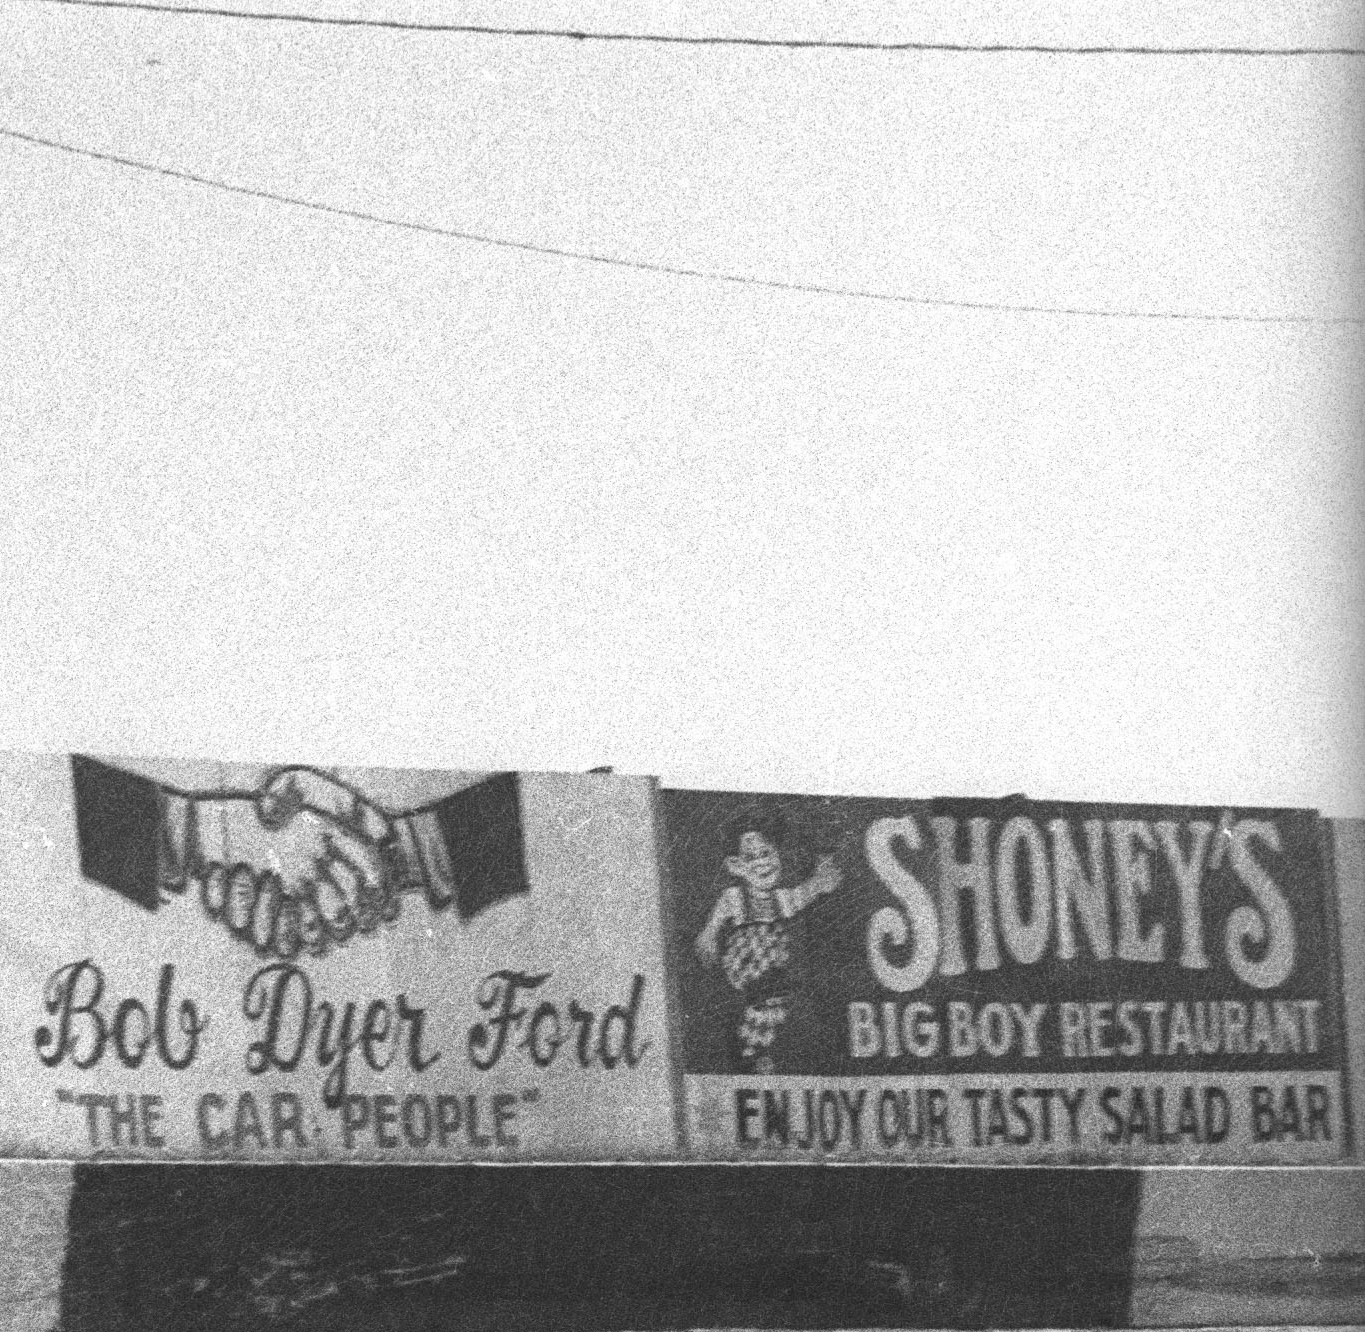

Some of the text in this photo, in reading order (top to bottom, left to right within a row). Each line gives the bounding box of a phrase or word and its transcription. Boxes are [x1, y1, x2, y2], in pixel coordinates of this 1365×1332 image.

[865, 812, 1297, 993] SHONEY'S
[34, 958, 654, 1109] Bob Dyer Ford
[847, 999, 1321, 1059] BIG BOY RESTAURANT
[734, 1082, 1333, 1151] ENJOY OUR TASTY SALAD BAR
